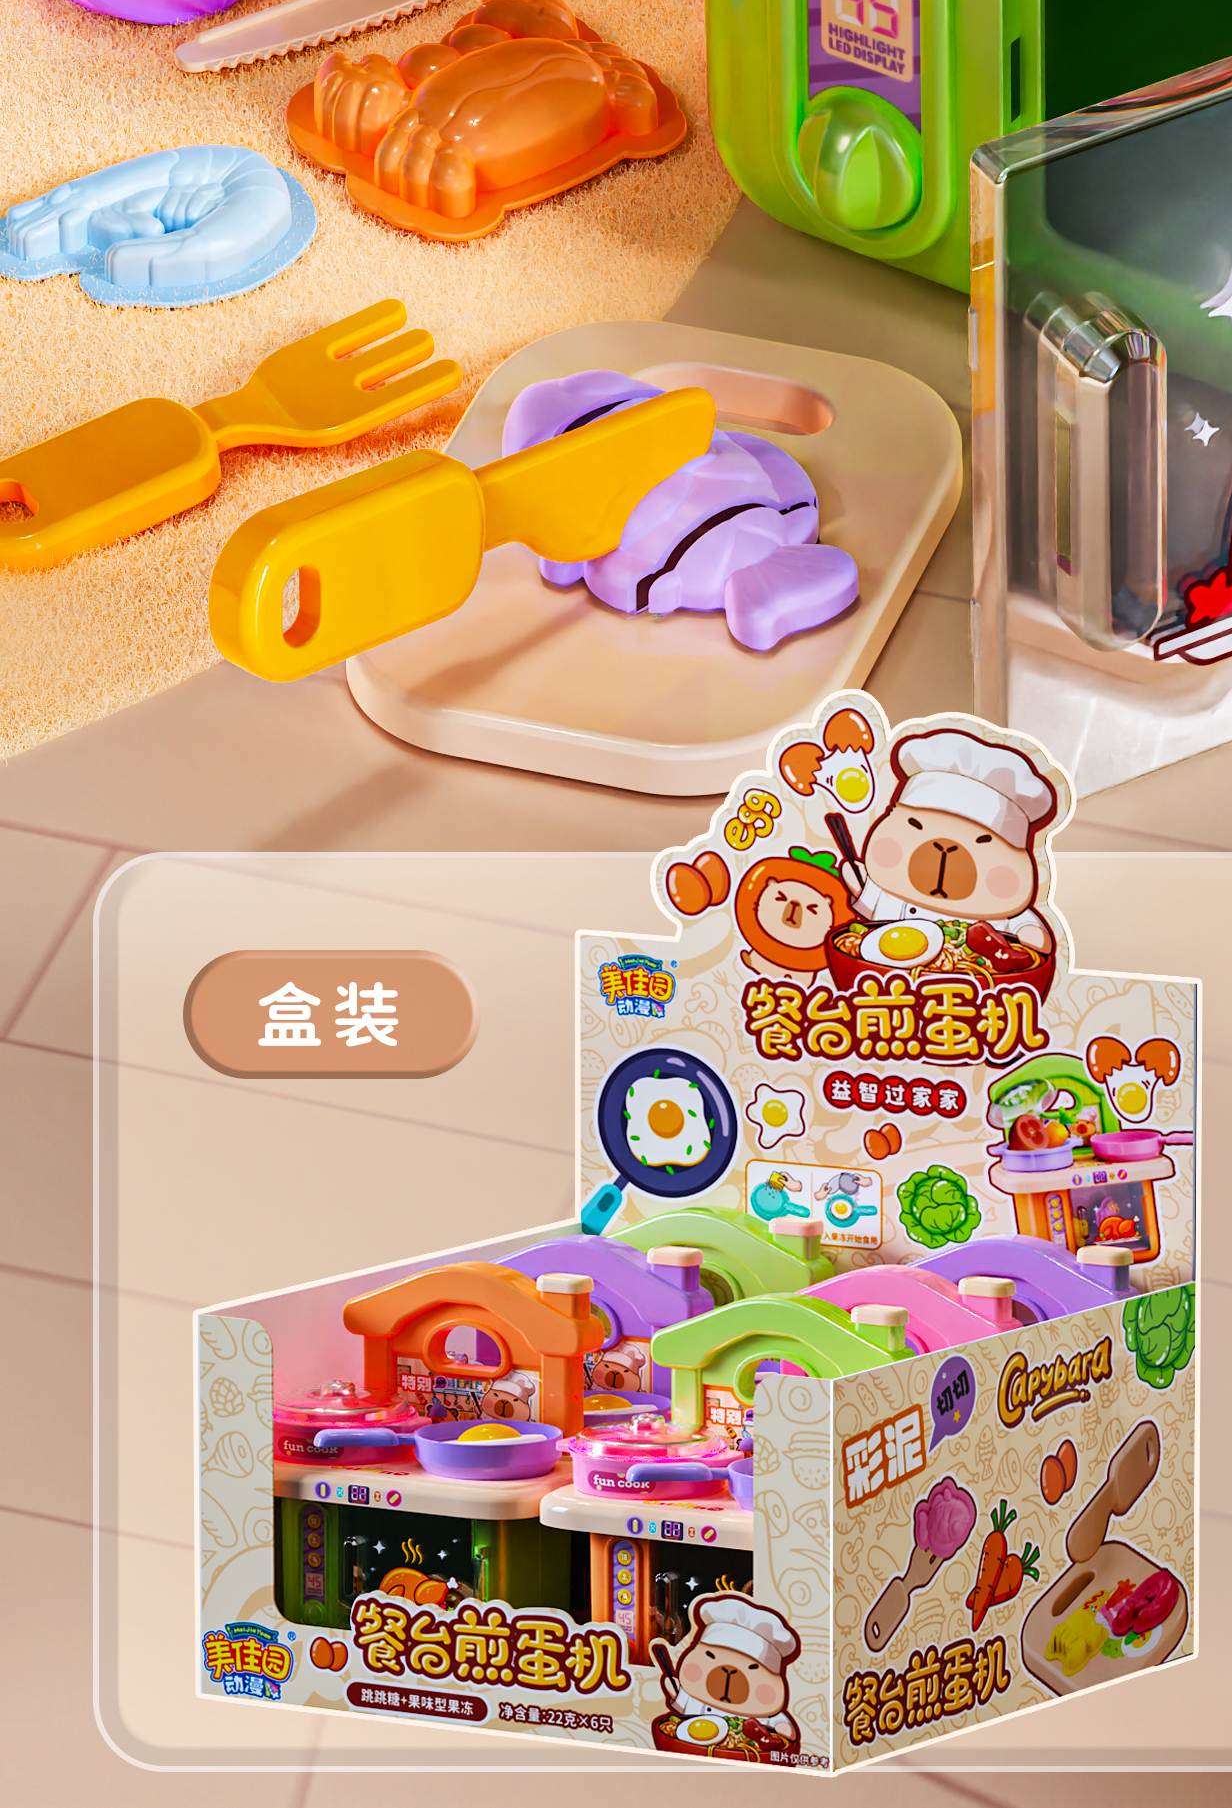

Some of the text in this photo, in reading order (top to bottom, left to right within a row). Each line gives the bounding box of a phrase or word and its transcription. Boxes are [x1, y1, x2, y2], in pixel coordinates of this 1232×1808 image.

[828, 22, 905, 61] HIGHLIGHT
[828, 36, 905, 75] LED DISPLAY
[725, 788, 782, 850] egg
[600, 964, 674, 1003] 美佳园
[746, 979, 1045, 1056] 餐台煎蛋机
[831, 1079, 959, 1111] 益智过家家
[402, 1374, 432, 1392] 特别
[936, 1370, 970, 1416] 切切
[999, 1337, 1112, 1426] Capybara
[710, 1407, 741, 1425] 特别
[283, 1440, 304, 1452] fun
[846, 1409, 923, 1501] 彩泥
[593, 1474, 615, 1487] fun
[205, 1634, 291, 1680] 美佳园
[356, 1602, 626, 1690] 餐台煎蛋机
[360, 1688, 474, 1716] 跳跳糖+果味型果冻
[847, 1641, 1008, 1741] 餐台煎蛋机
[500, 1703, 614, 1733] 净含量:22克×6只
[770, 1750, 829, 1768] 图片仅供参考
